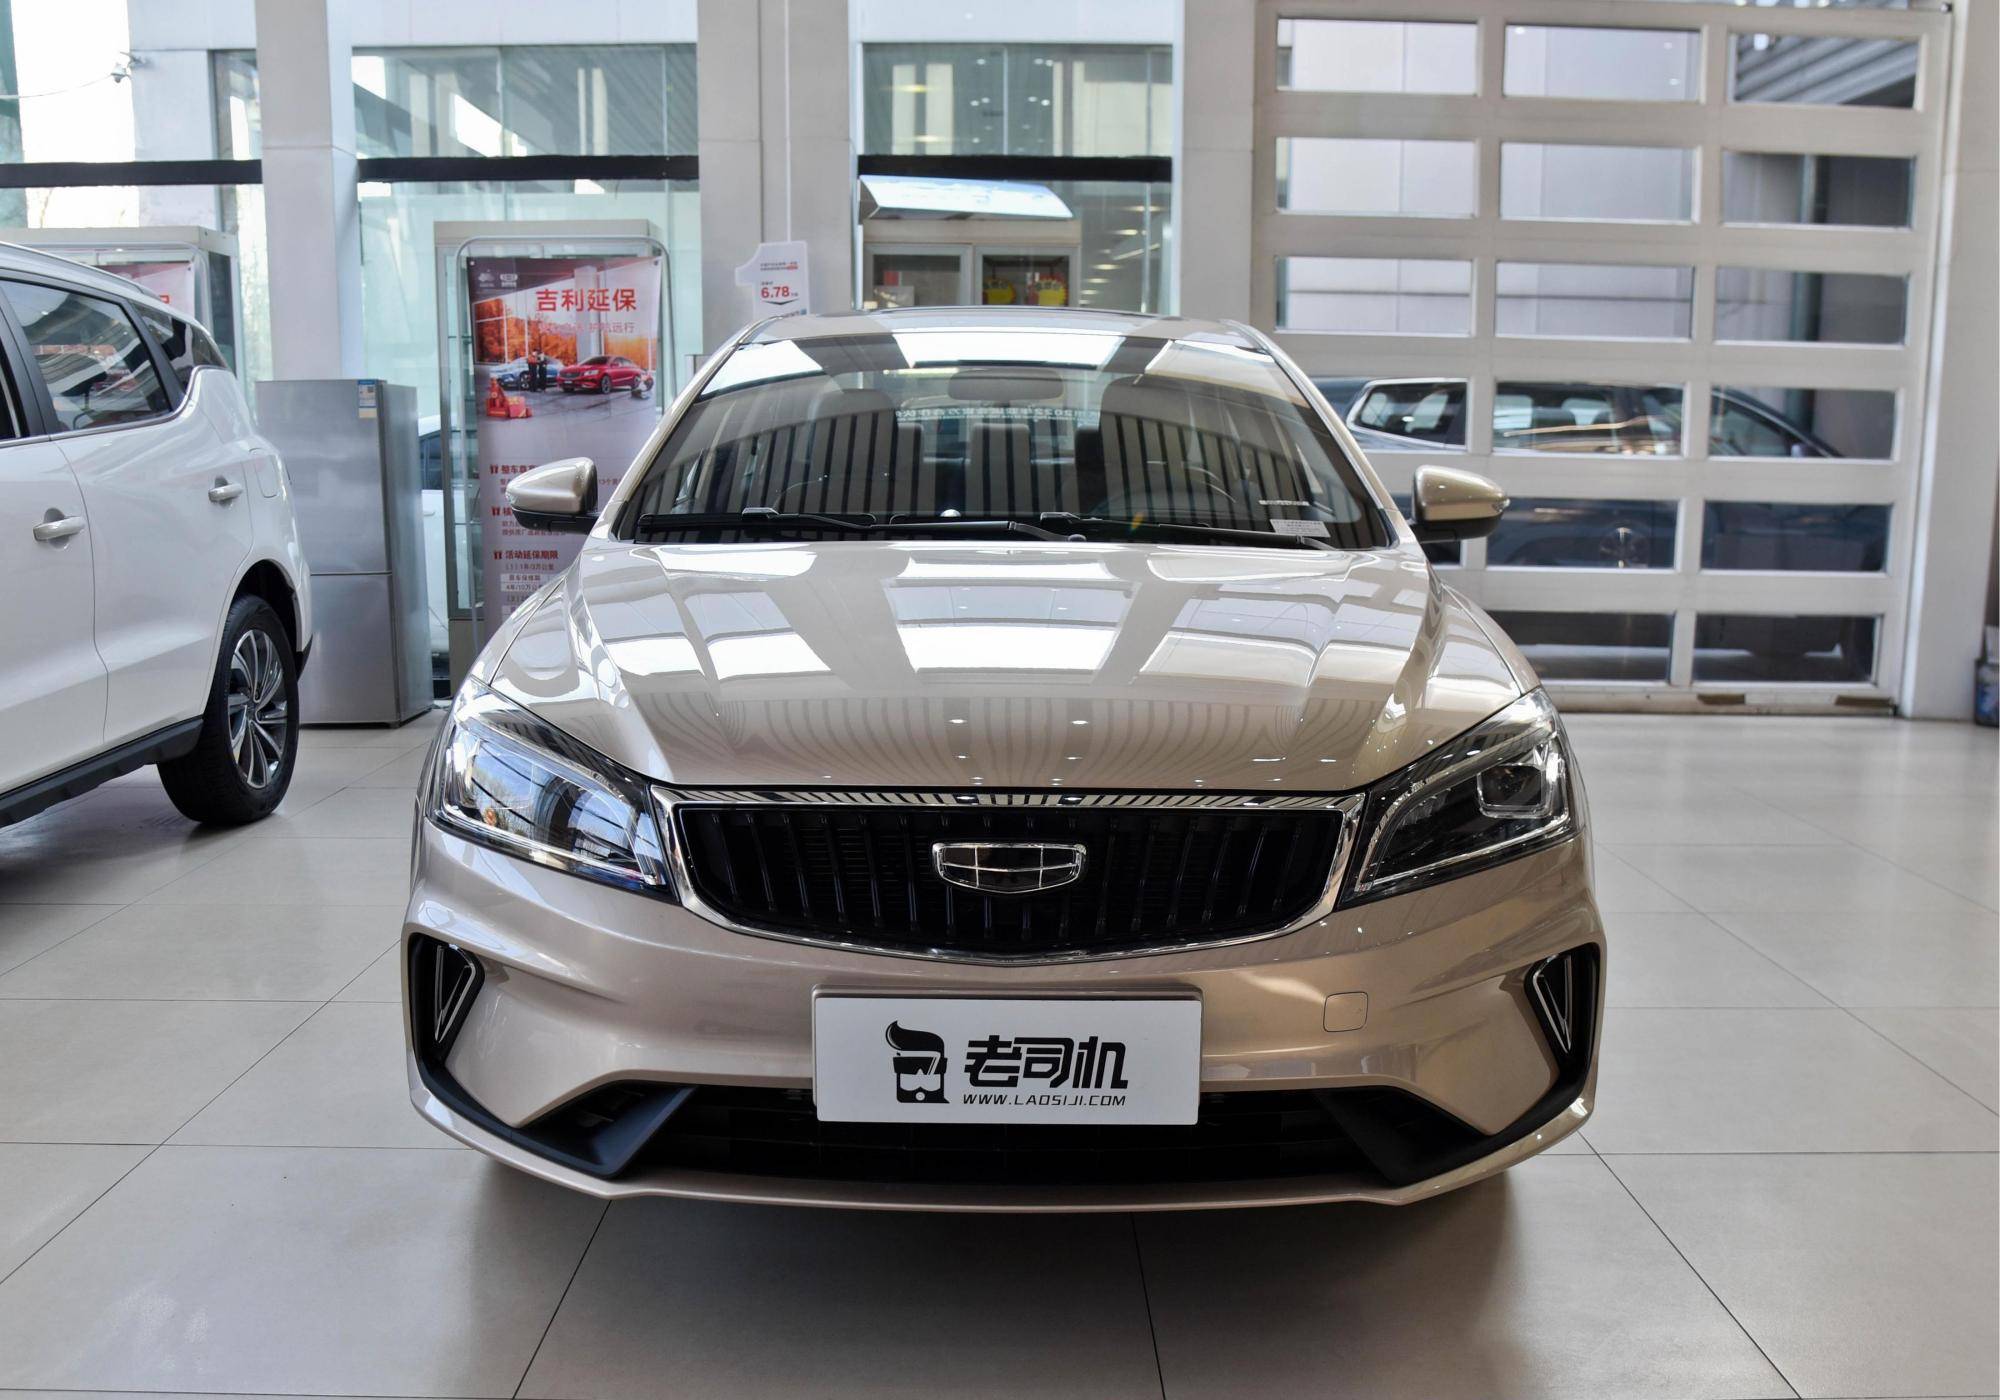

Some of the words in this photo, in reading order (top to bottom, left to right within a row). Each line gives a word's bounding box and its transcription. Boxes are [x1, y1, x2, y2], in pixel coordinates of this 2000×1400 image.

[761, 286, 790, 299] 6.78
[536, 288, 637, 312] 吉利延保
[505, 550, 559, 560] 活动延保期限
[964, 1035, 1129, 1089] 老司机
[963, 1094, 1126, 1107] WWW.LAOSIJI.COM
